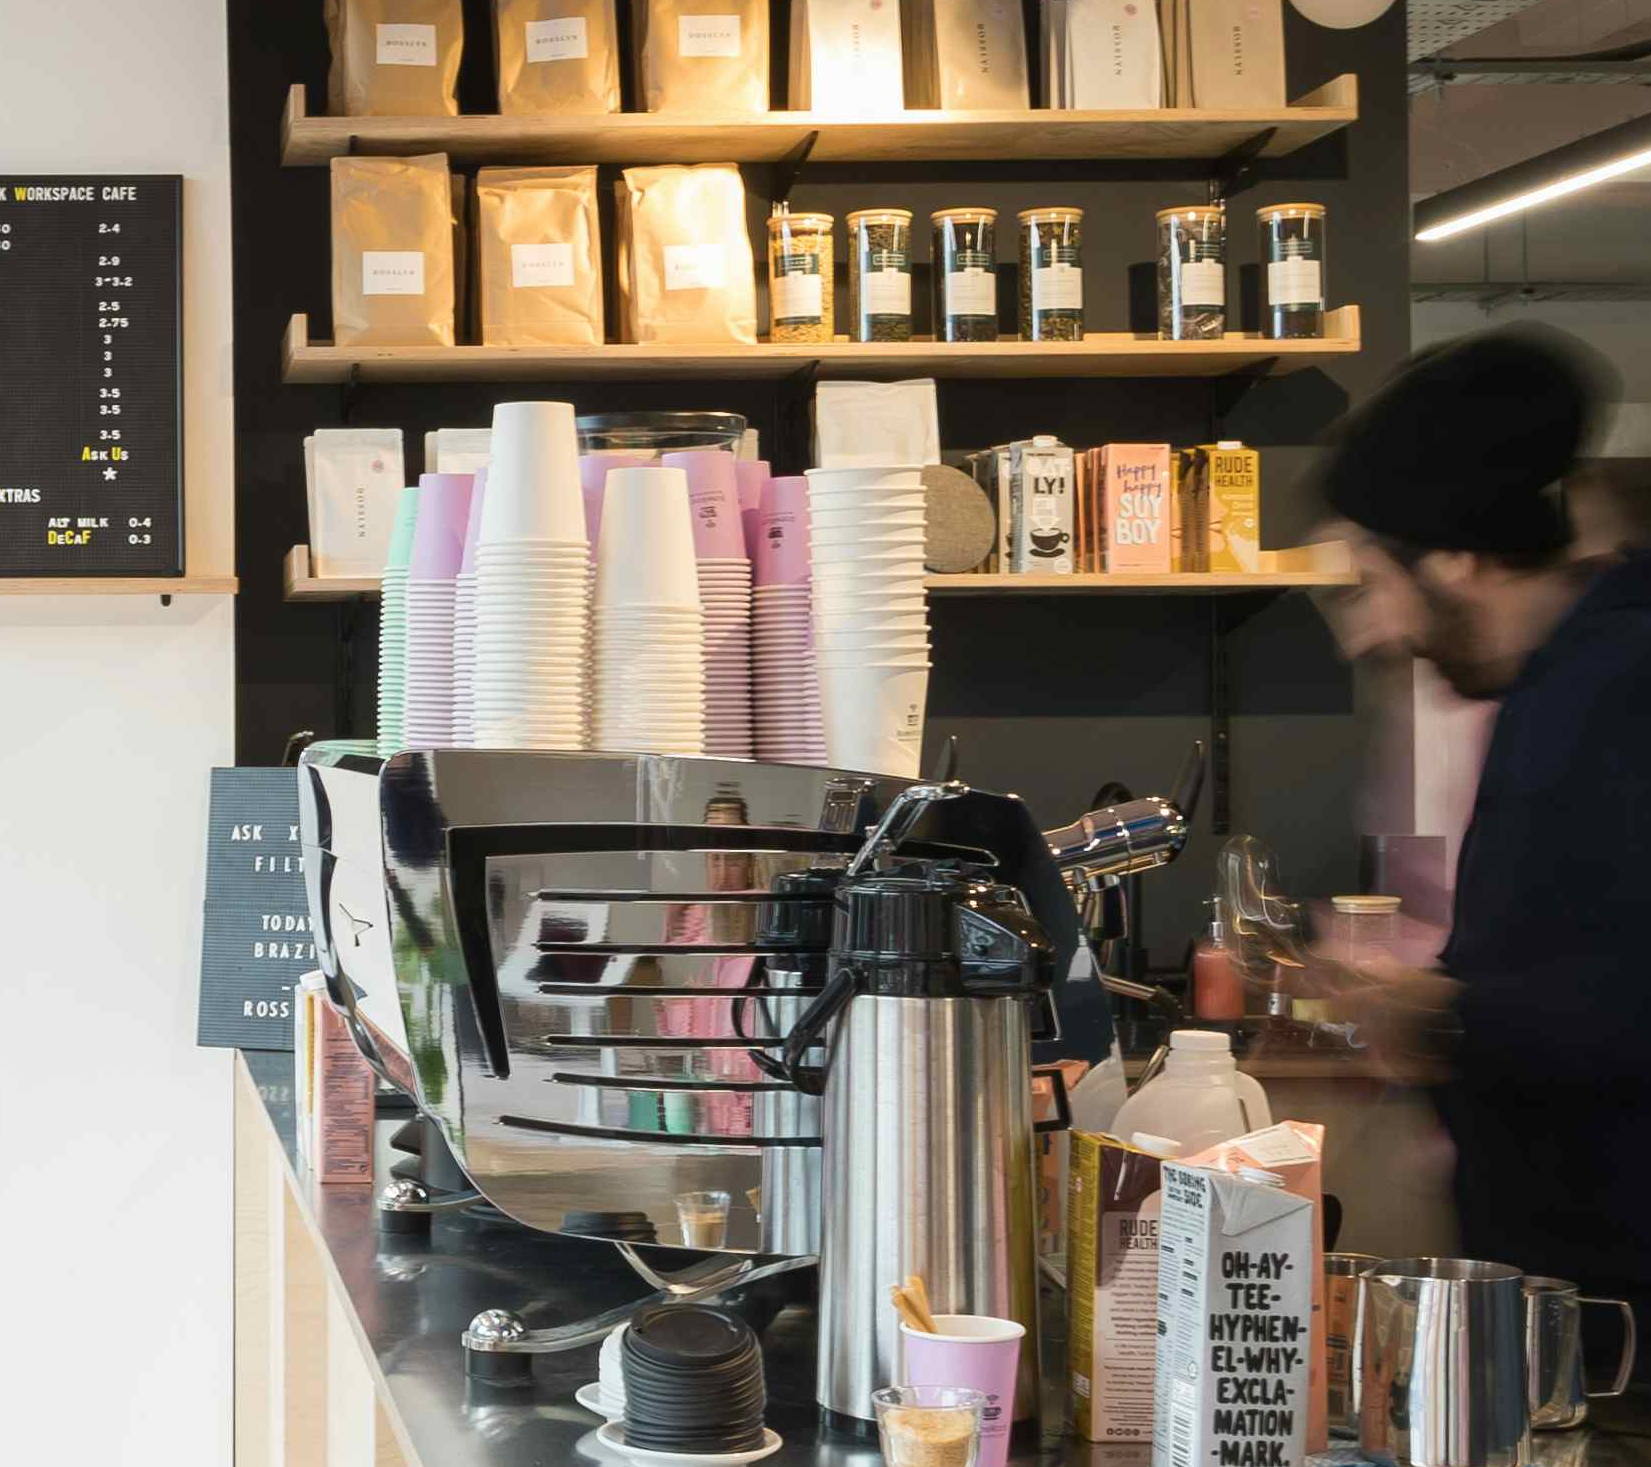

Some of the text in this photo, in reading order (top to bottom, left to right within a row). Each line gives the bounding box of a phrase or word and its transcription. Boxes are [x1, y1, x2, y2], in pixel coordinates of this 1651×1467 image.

[14, 187, 95, 201] WORKSPACE
[102, 187, 137, 201] CAFE
[99, 224, 120, 234] 2.4
[99, 257, 120, 266] 2.9
[99, 302, 120, 311] 2.5
[99, 318, 129, 327] 2.75
[104, 335, 112, 344] 3
[104, 351, 112, 361] 3
[104, 368, 112, 378] 3
[100, 389, 120, 398] 3.5
[100, 405, 120, 414] 3.5
[100, 430, 120, 440] 3.5
[82, 447, 108, 461] ASK
[112, 447, 128, 461] US
[1215, 456, 1253, 474] RUDE
[1034, 477, 1065, 494] LY!
[1214, 475, 1253, 487] HEALTH
[48, 518, 70, 528] ALT
[78, 518, 108, 528] MILK
[1115, 517, 1162, 544] BOY
[232, 825, 262, 841] ASK
[1119, 1220, 1159, 1237] RUDE
[1119, 1237, 1159, 1250] HEALTH
[1222, 1252, 1294, 1280] OH-AY-
[1226, 1283, 1280, 1310] TEE-
[1209, 1314, 1306, 1343] HYPHEN-
[1211, 1346, 1304, 1373] EL-WHY-
[1217, 1377, 1295, 1405] EXCLA-
[1213, 1409, 1293, 1436] MATION
[1211, 1440, 1290, 1467] -MARK.
